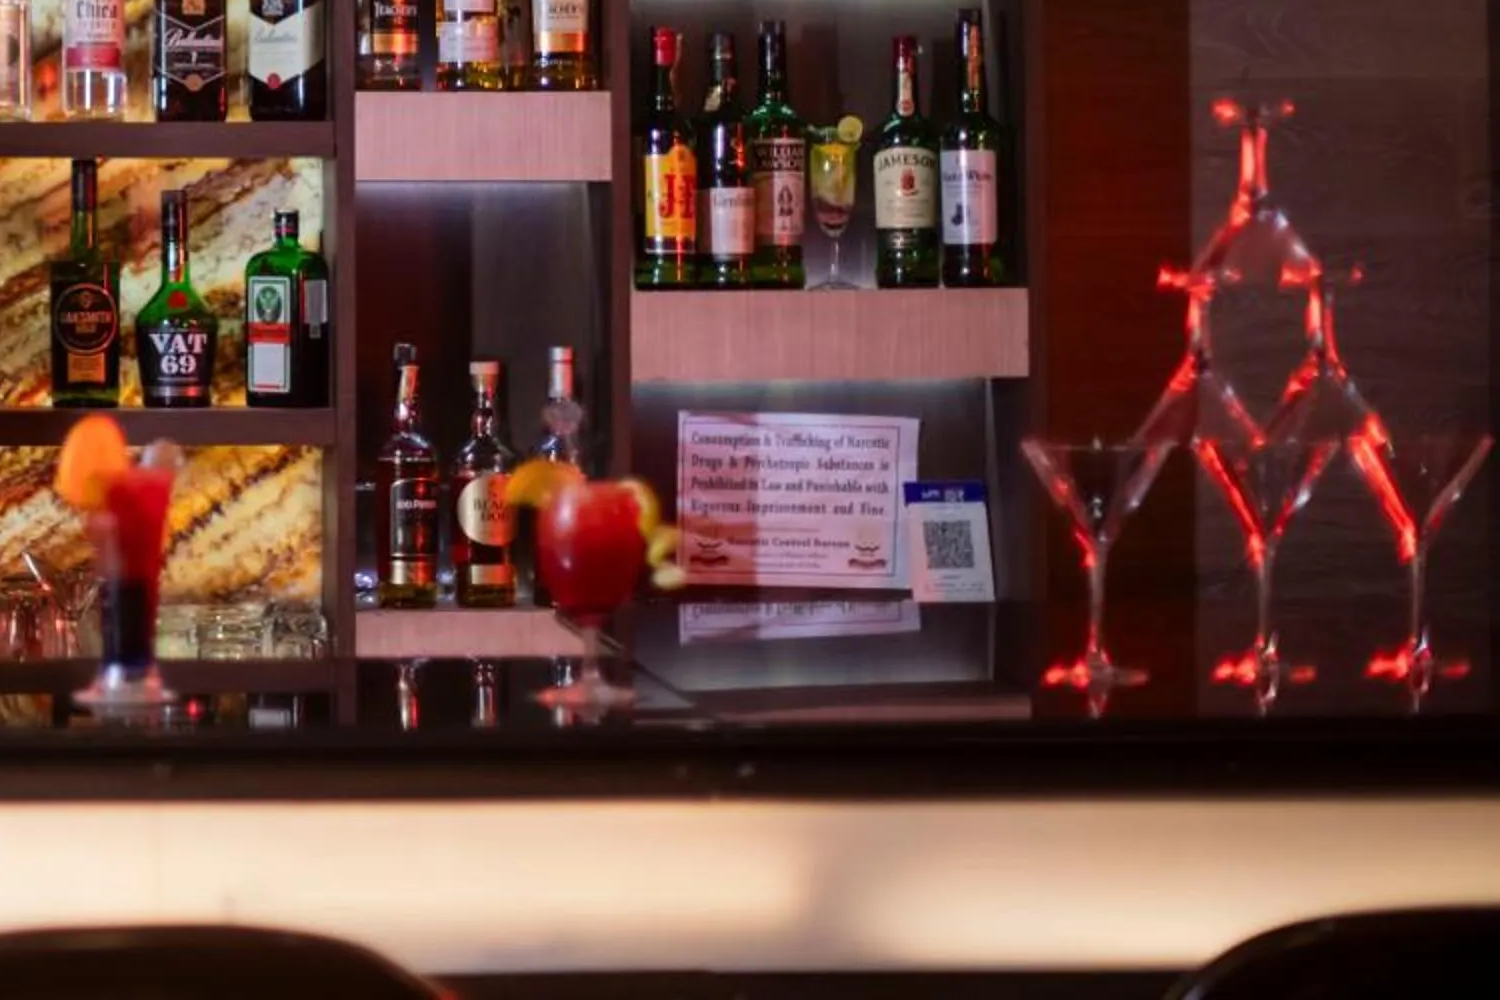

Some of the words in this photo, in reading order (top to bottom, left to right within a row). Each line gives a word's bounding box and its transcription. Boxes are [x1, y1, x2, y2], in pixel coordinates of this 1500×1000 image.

[149, 333, 207, 354] VAT
[161, 354, 197, 375] 69
[691, 430, 761, 450] Consumption
[691, 454, 723, 472] Drugs
[817, 457, 875, 471] Substances
[785, 479, 803, 491] and
[865, 480, 890, 495] with
[746, 497, 827, 517] Imprisonment
[833, 501, 854, 516] and
[860, 501, 885, 516] Fine
